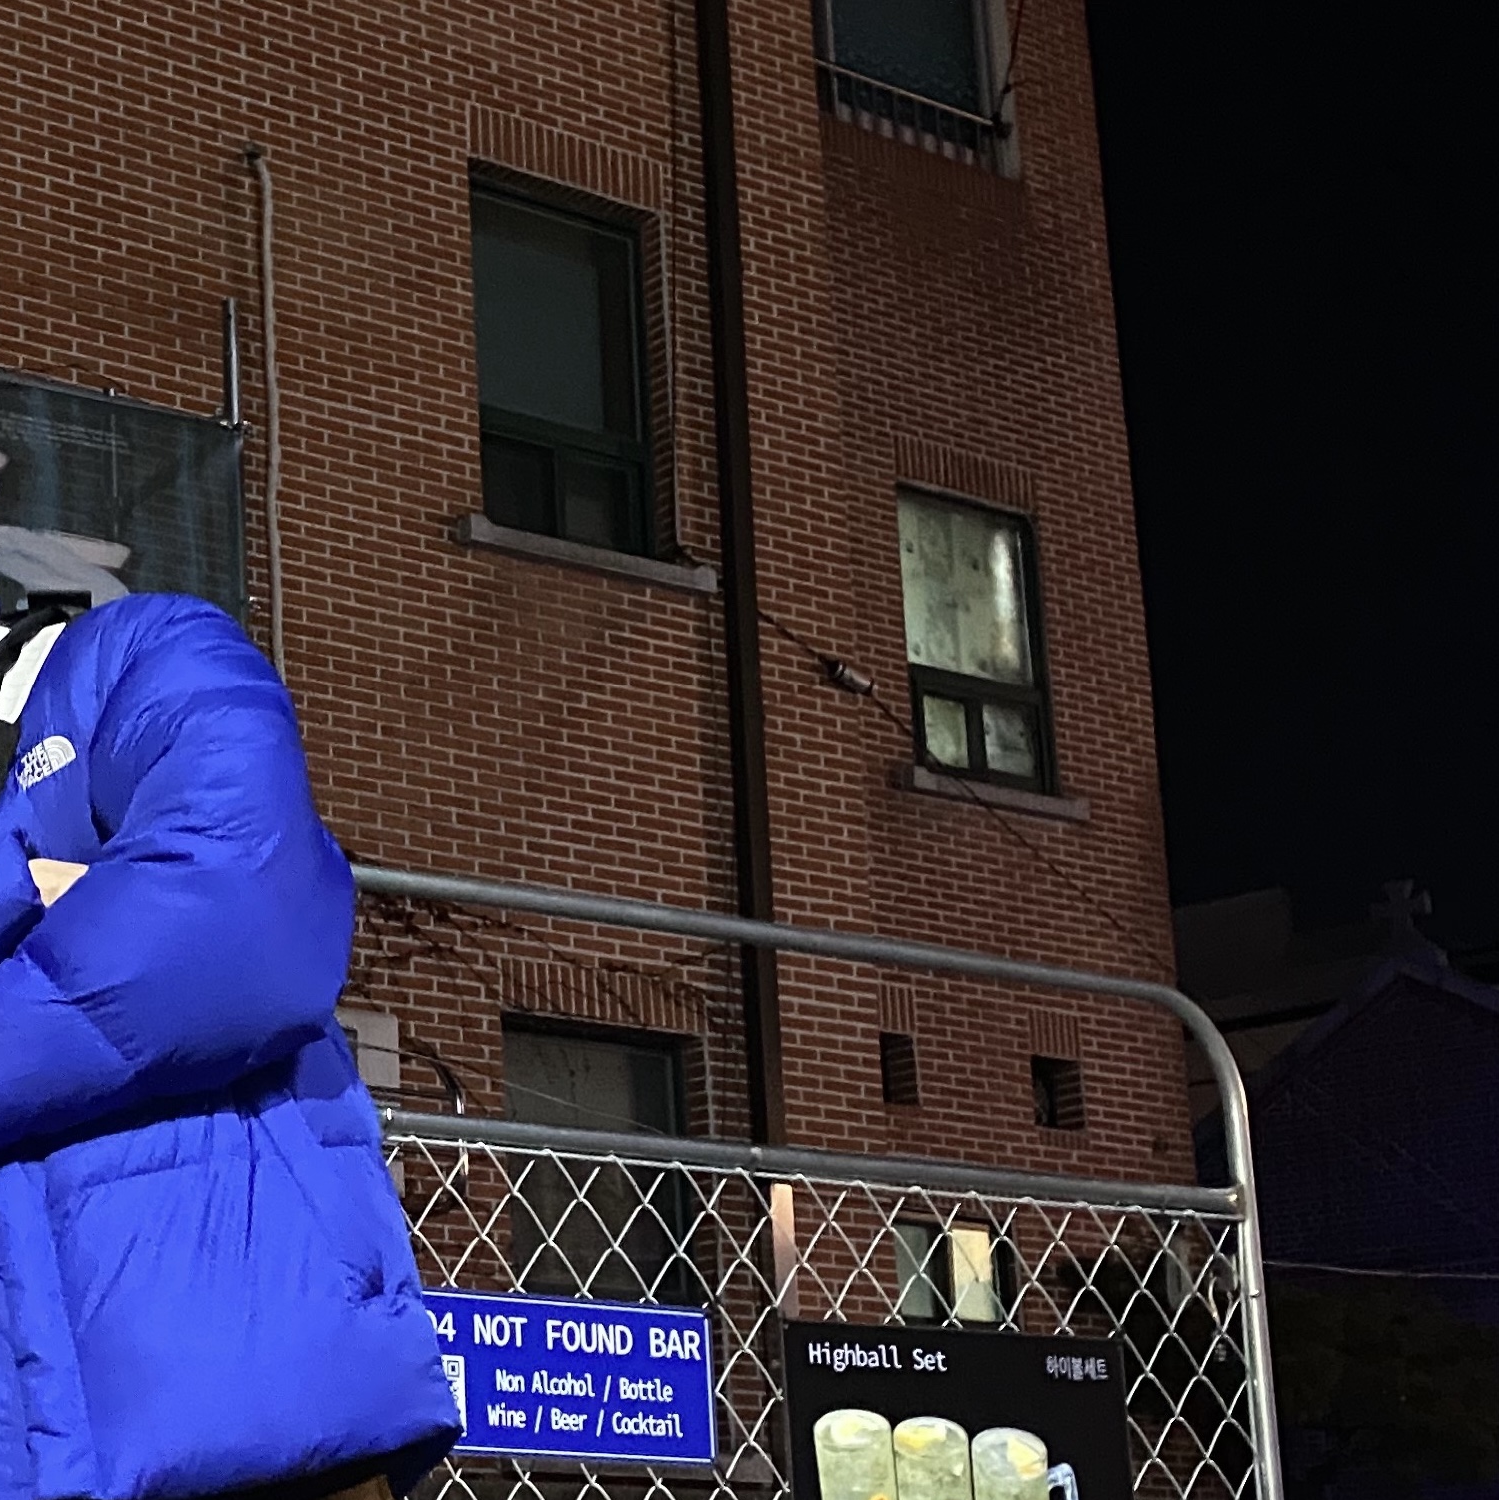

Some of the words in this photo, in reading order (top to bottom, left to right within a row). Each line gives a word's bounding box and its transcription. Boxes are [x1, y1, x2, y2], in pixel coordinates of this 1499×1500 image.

[473, 1314, 528, 1348] NOT
[546, 1319, 634, 1356] FOUND
[649, 1326, 701, 1361] BAR
[808, 1342, 902, 1373] Highball
[913, 1348, 948, 1372] Set
[495, 1368, 525, 1393] Non
[531, 1371, 596, 1398] Alcohol
[603, 1375, 612, 1403] /
[619, 1376, 674, 1403] Bottle
[487, 1404, 527, 1429] Wine
[534, 1405, 543, 1434] /
[550, 1407, 588, 1432] Beer
[596, 1409, 605, 1437] /
[612, 1413, 684, 1439] Cocktail
